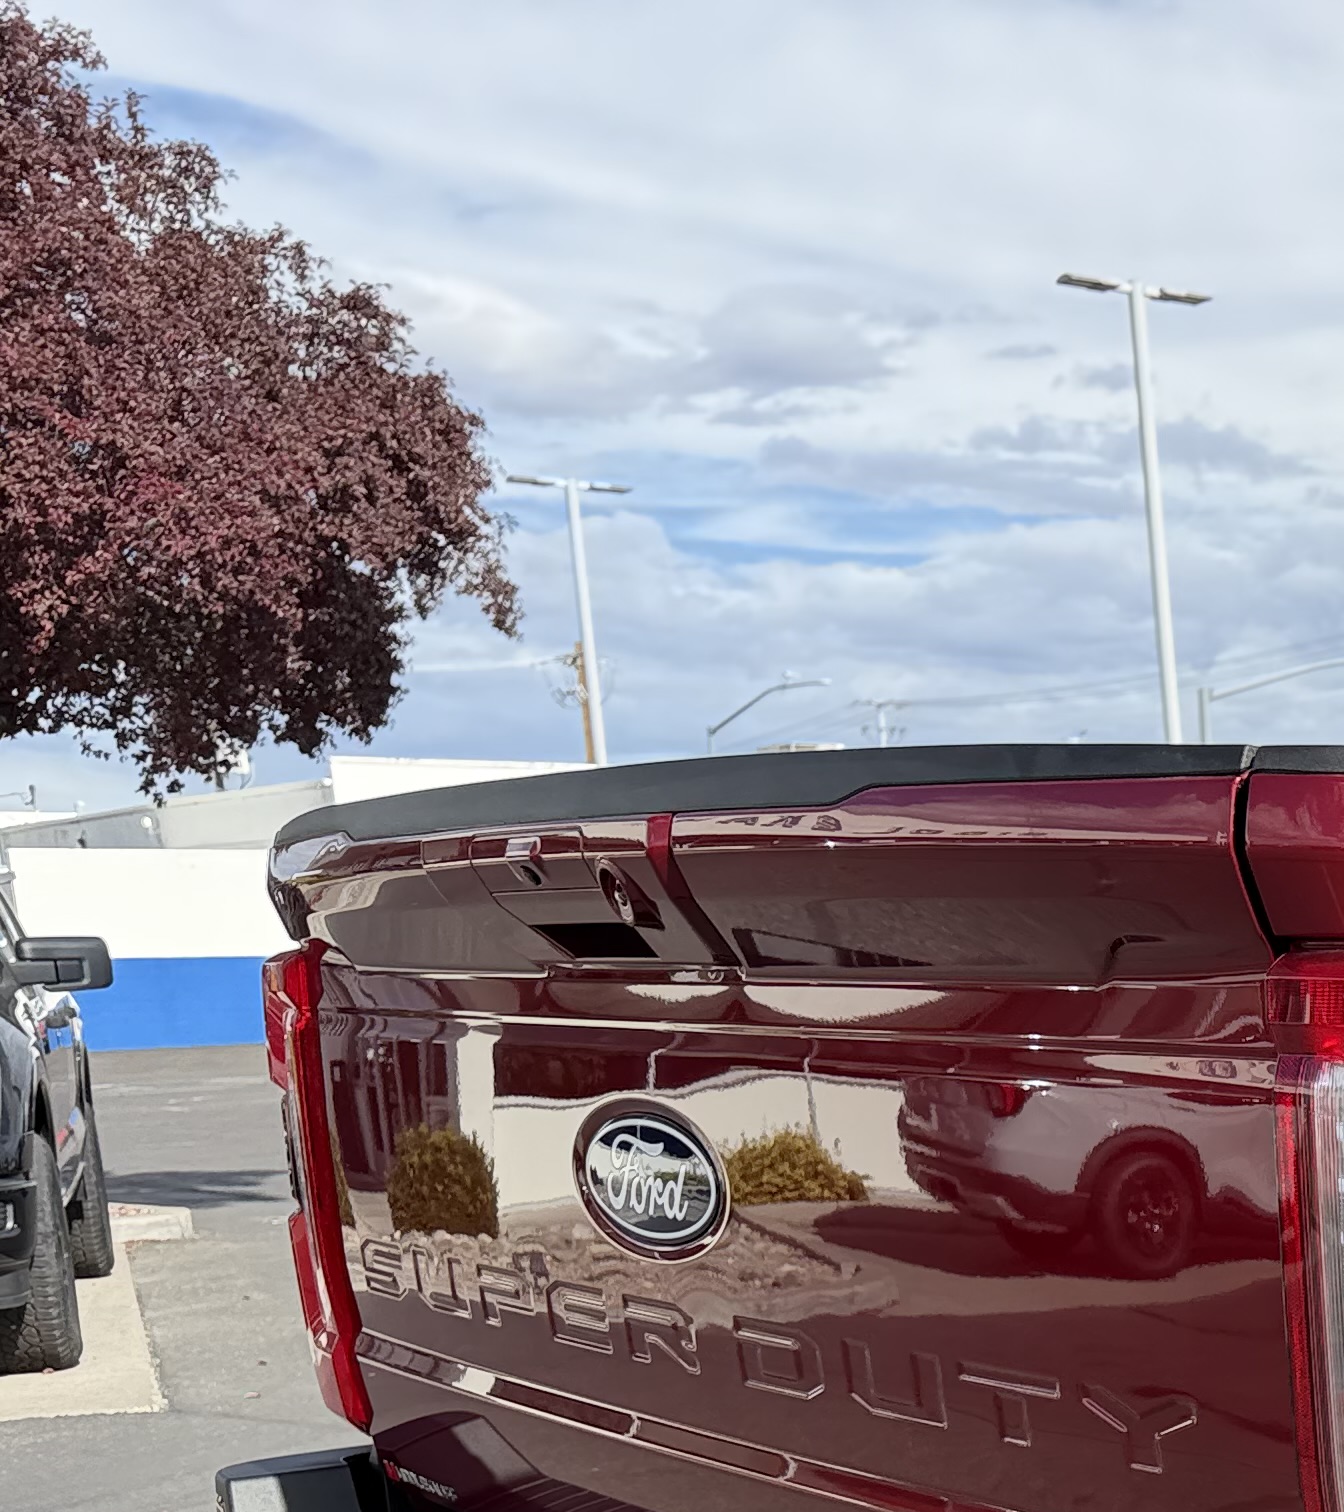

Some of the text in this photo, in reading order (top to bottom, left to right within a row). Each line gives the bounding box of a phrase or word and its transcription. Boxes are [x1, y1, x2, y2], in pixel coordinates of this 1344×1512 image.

[607, 1133, 689, 1222] Ford
[362, 1236, 1198, 1474] SUPER DUTY
